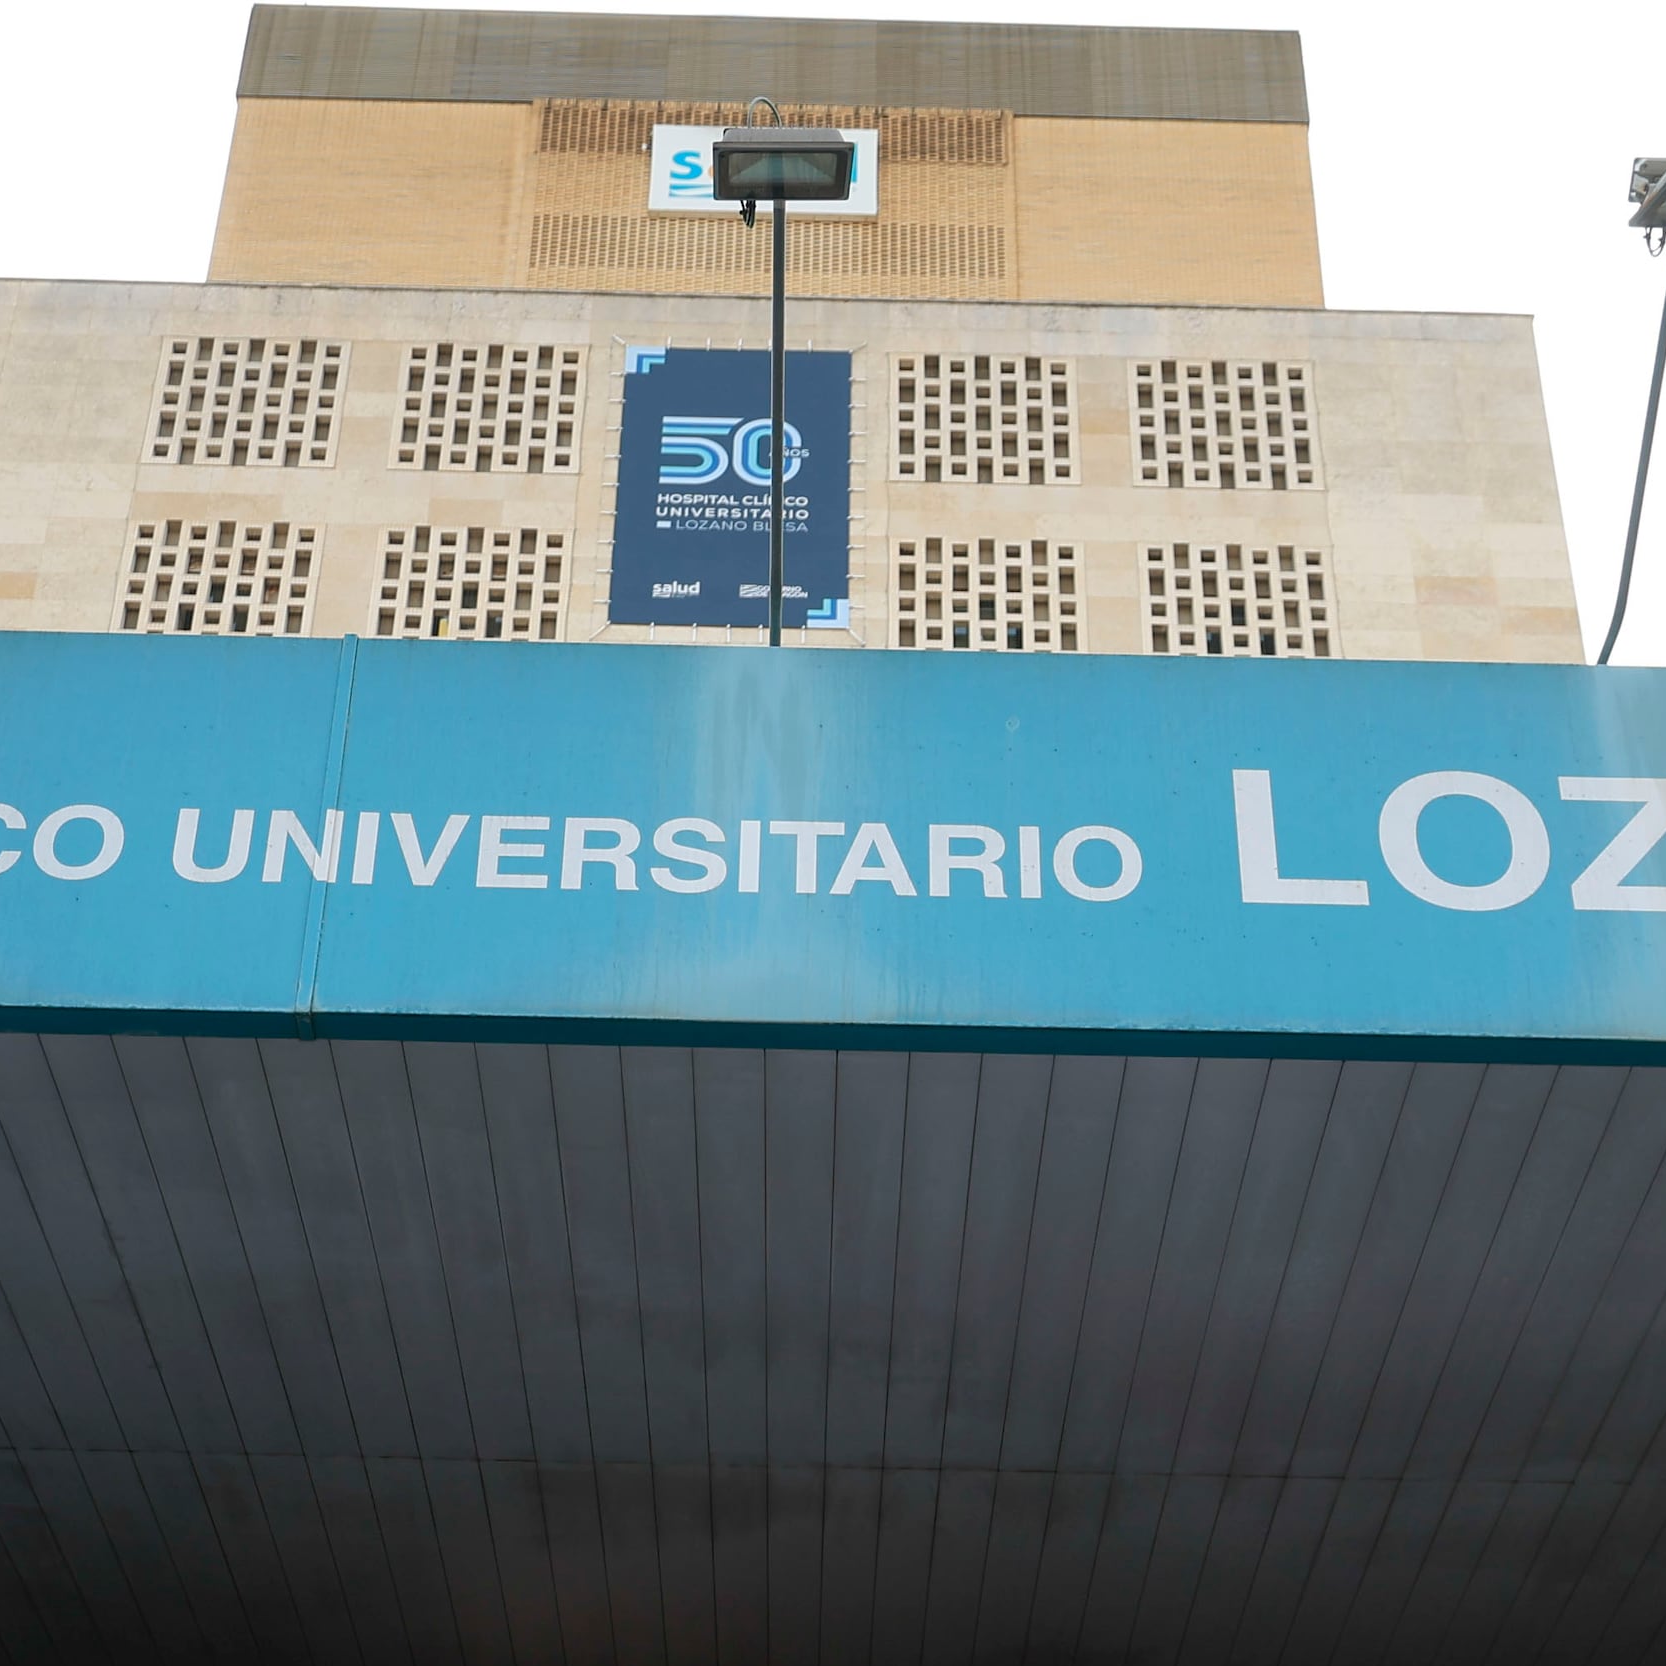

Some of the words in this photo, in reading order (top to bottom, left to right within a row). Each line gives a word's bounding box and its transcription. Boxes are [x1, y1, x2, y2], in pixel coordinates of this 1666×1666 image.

[659, 416, 802, 486] 50
[657, 493, 739, 505] HOSPITAL
[676, 519, 747, 531] LOZANO
[652, 581, 700, 595] salud
[173, 808, 1142, 901] UNIVERSITARIO
